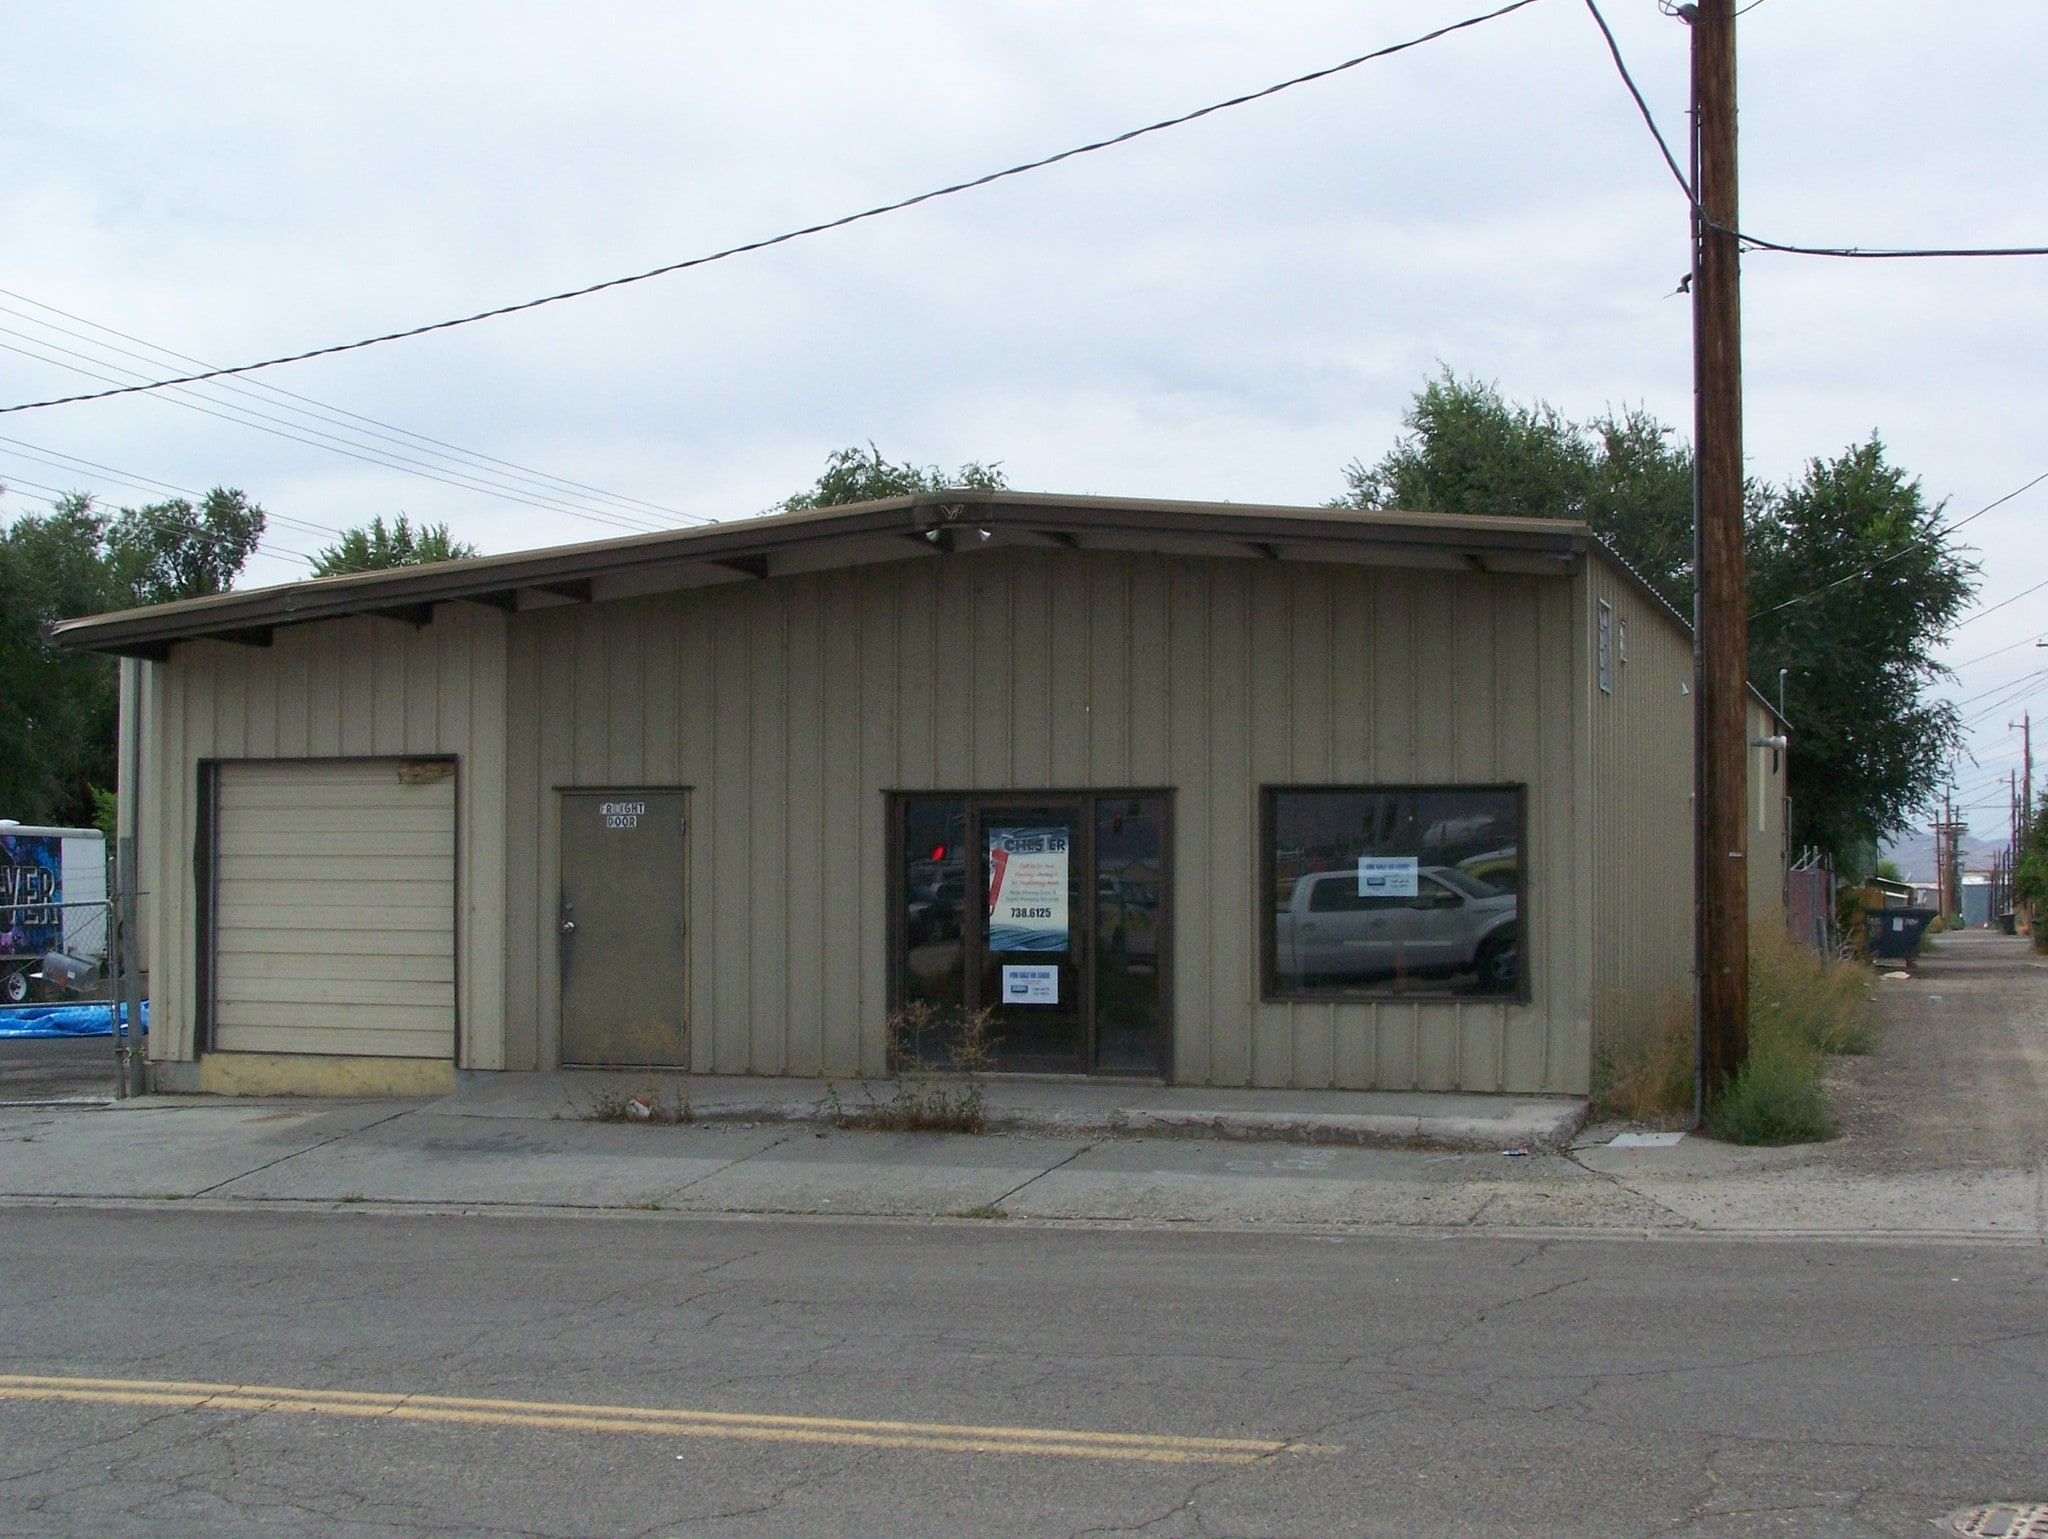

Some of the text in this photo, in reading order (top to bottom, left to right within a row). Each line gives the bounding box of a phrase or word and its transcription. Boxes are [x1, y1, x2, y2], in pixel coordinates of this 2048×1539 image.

[601, 803, 645, 815] FRIGHT
[608, 816, 636, 827] DOOR
[1004, 835, 1065, 851] CHESTER
[1010, 907, 1051, 919] 738.6125
